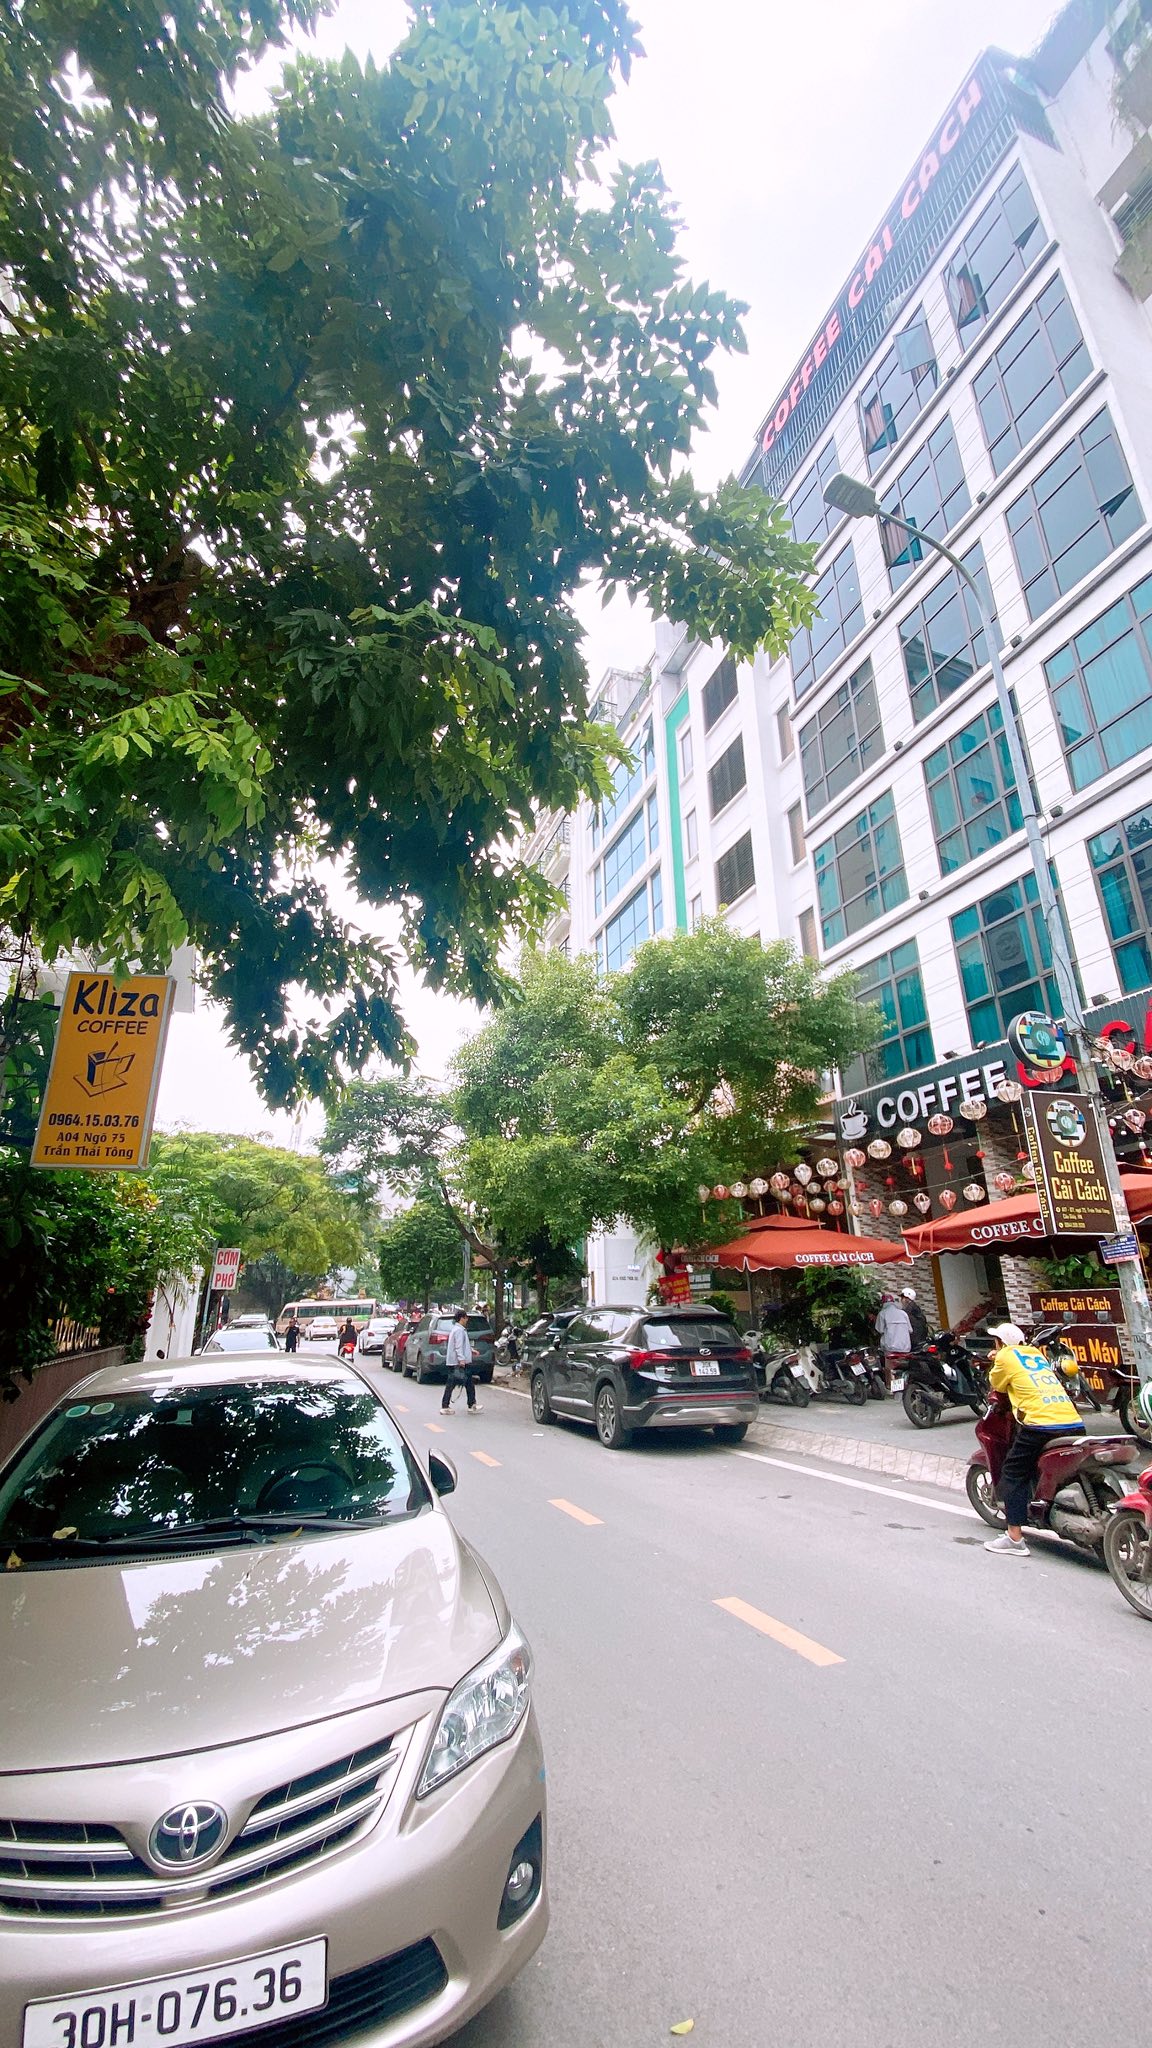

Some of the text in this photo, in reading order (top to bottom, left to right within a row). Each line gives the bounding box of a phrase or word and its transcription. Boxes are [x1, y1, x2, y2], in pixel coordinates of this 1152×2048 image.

[762, 311, 841, 452] COFFEE
[72, 979, 160, 1018] Kliza
[77, 1019, 149, 1035] COFFEE
[876, 1060, 1006, 1128] COFFEE
[48, 1112, 140, 1128] 0964.15.03.76
[56, 1131, 80, 1142] A04
[111, 1133, 126, 1143] 75
[1027, 1126, 1039, 1164] Coffee
[75, 1144, 101, 1157] Thái
[104, 1146, 134, 1160] Tông
[1053, 1150, 1095, 1174] Coffee
[1050, 1176, 1107, 1201] Cải Cách
[970, 1220, 1031, 1240] COFFEE
[216, 1250, 240, 1265] CƠM
[795, 1254, 831, 1263] COFFEE
[849, 1251, 875, 1262] CÁCH
[214, 1268, 236, 1288] PHỞ
[1040, 1296, 1112, 1311] Coffee Cải Cách
[1088, 1338, 1119, 1367] Máy
[52, 1959, 303, 2048] 30H-076.36
